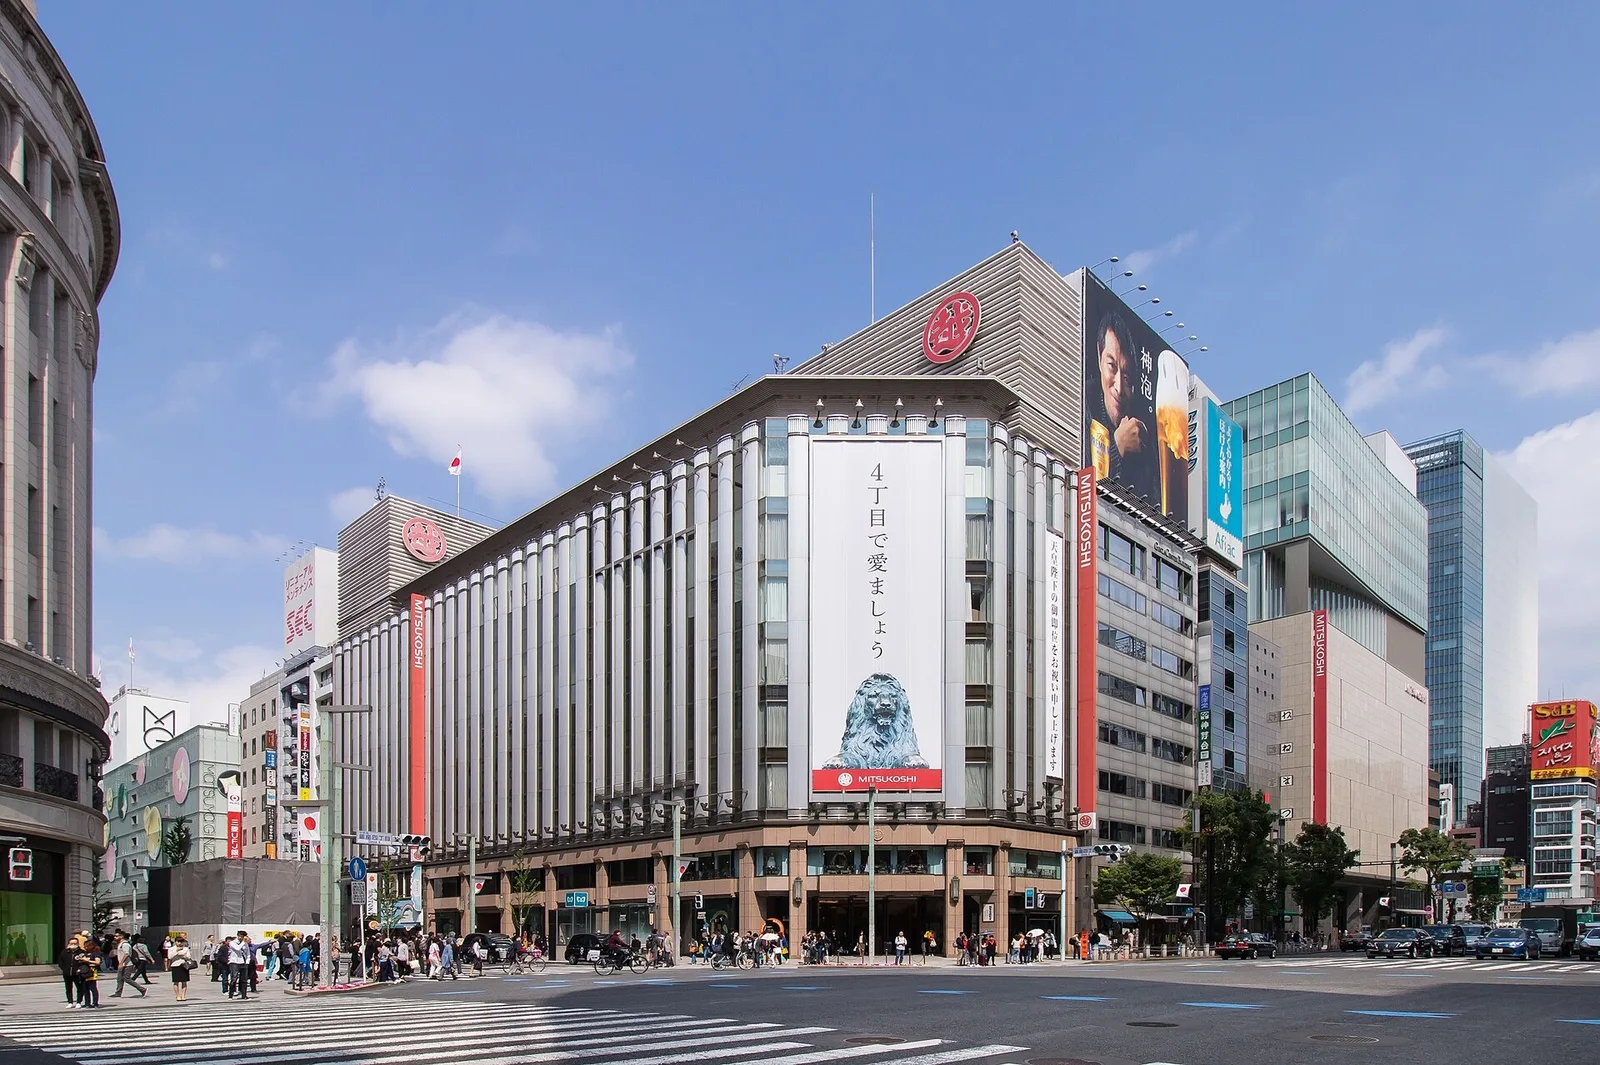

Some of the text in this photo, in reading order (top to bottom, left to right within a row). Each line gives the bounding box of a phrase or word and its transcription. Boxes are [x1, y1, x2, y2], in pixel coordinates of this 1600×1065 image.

[1140, 346, 1153, 413] 神泡。
[1219, 418, 1227, 489] ほけん案内
[1080, 473, 1091, 568] MITSUKOSHI
[1215, 532, 1236, 558] Aflac
[867, 462, 888, 660] 4丁目で愛ましょう
[286, 564, 313, 590] リニューアル
[286, 578, 313, 604] メンテナンス
[414, 599, 424, 669] MITSUKOSHI
[1316, 614, 1325, 677] MITSUKOSHI
[1536, 704, 1576, 718] S&B
[1538, 742, 1573, 756] スパイス
[1545, 753, 1572, 766] ハーブ
[858, 775, 917, 783] MITSUKOSHI
